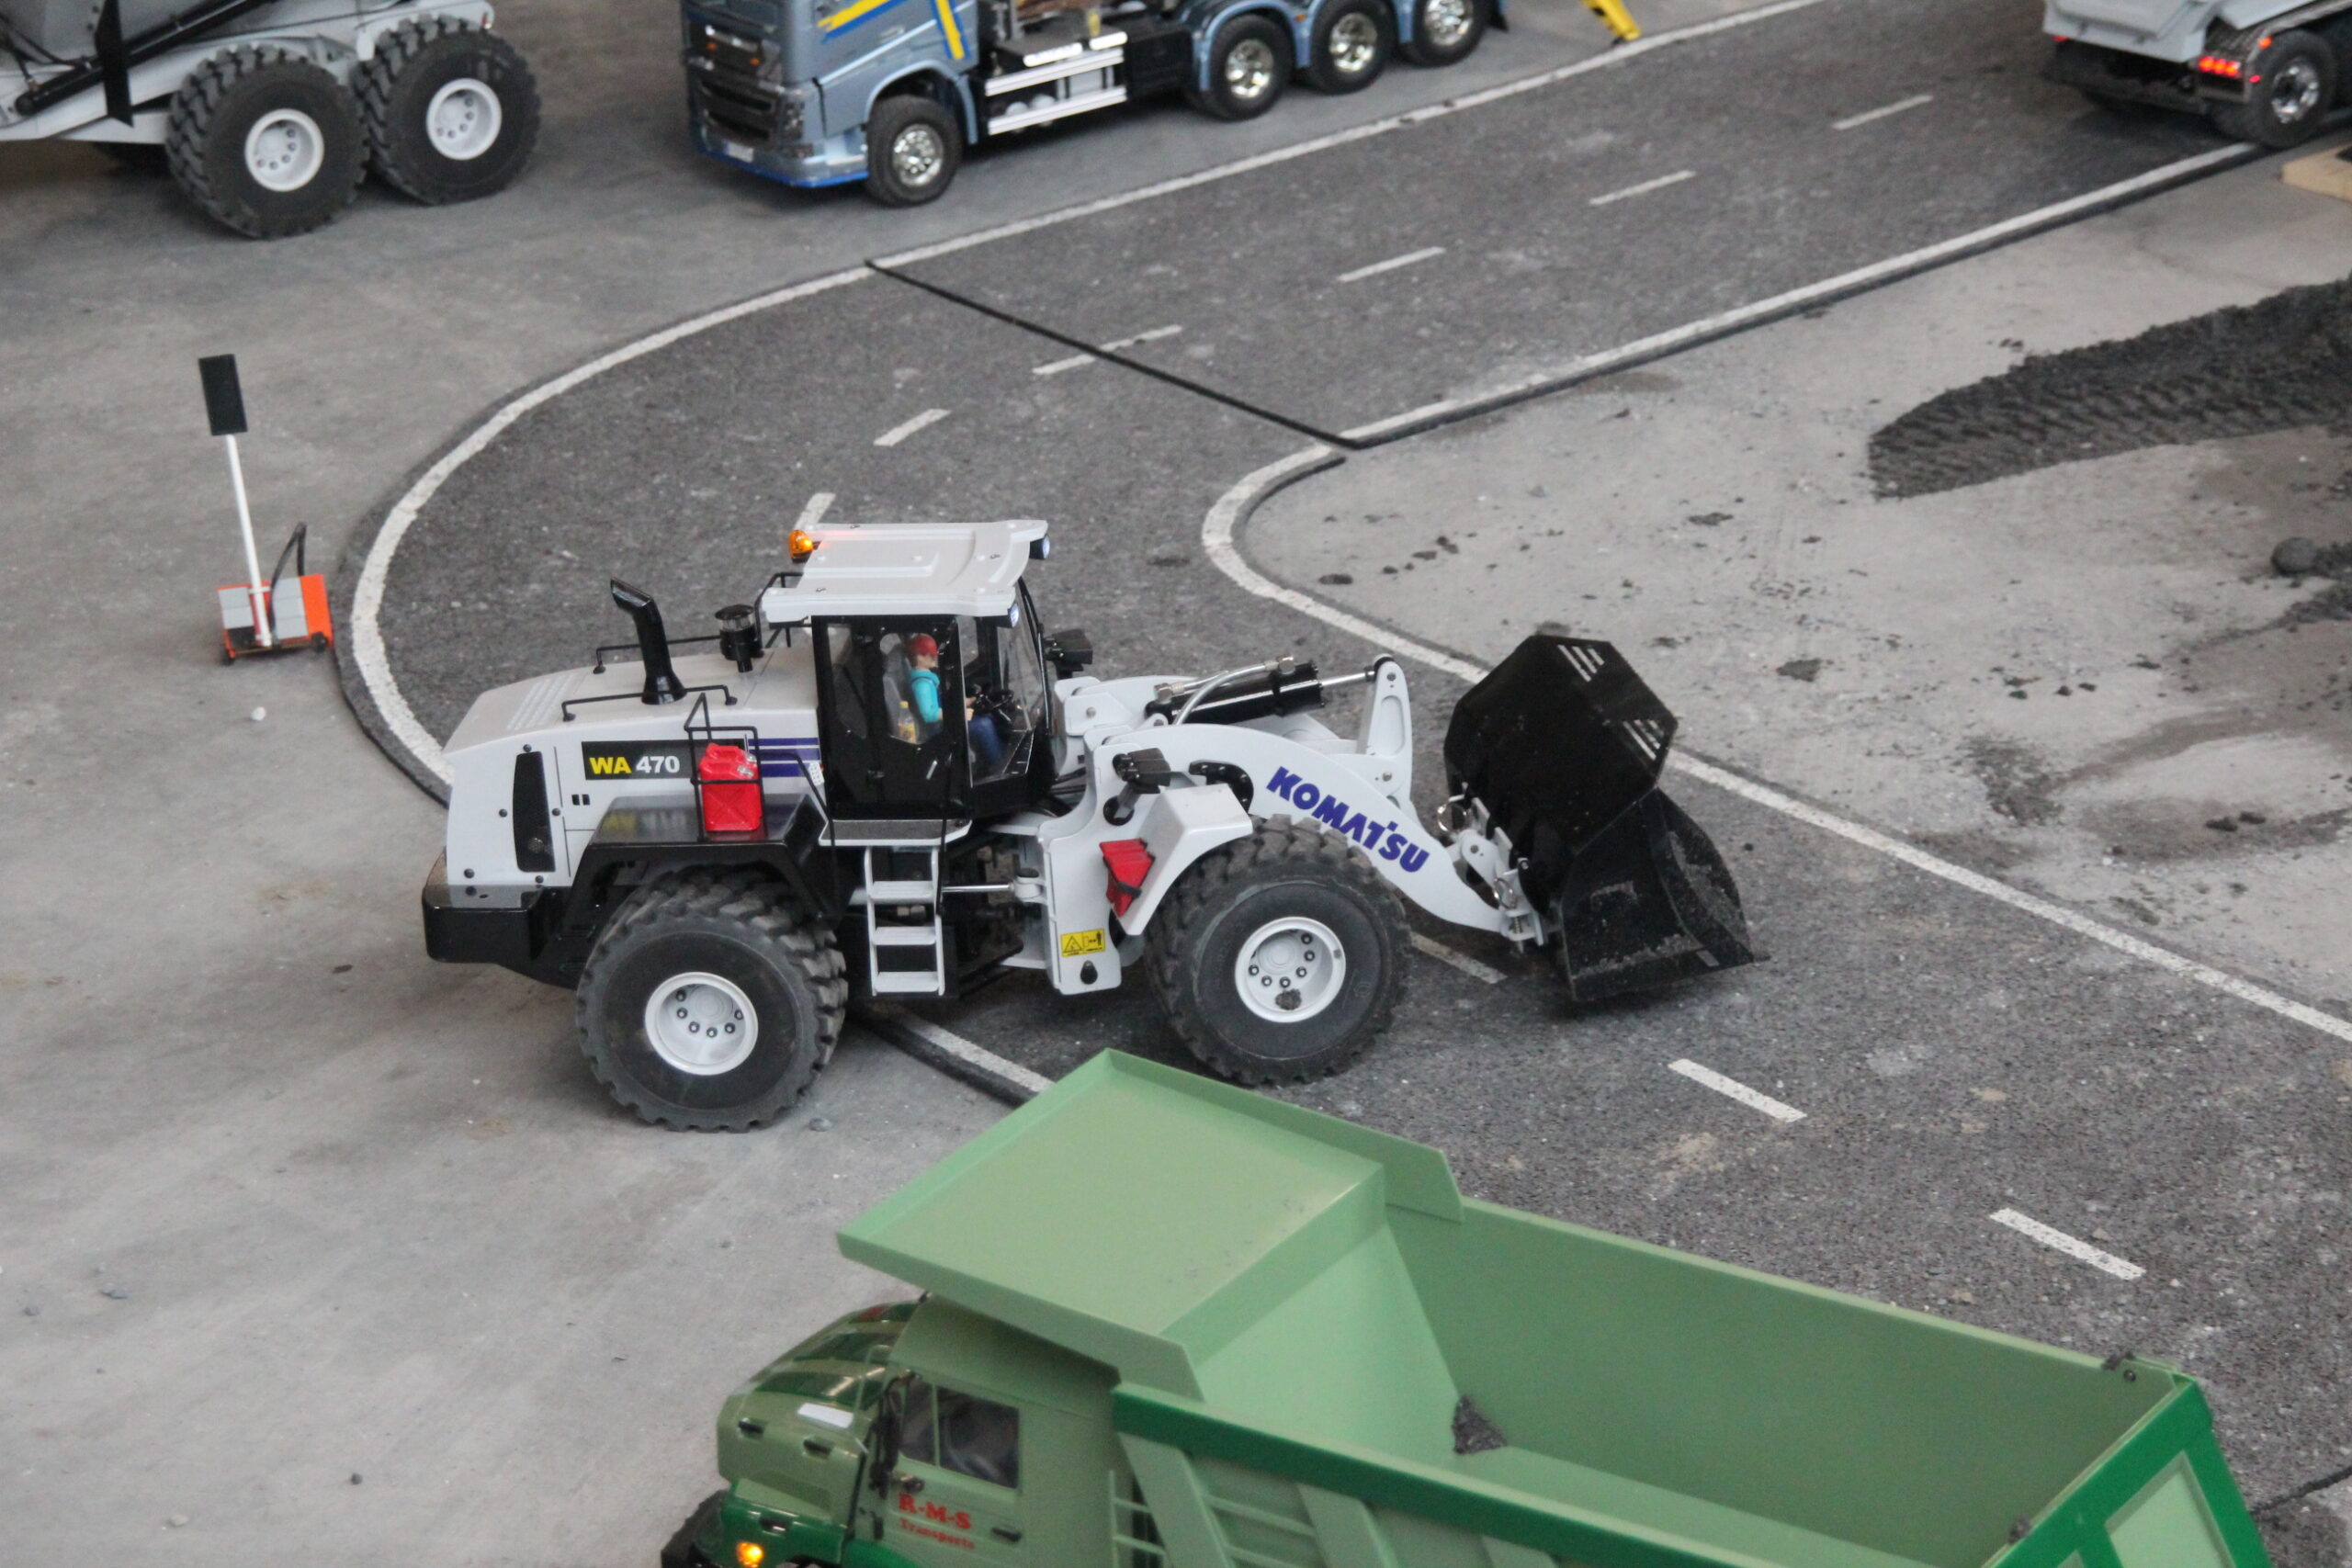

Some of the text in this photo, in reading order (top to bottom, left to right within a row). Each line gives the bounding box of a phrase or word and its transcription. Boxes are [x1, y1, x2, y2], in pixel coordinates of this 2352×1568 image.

[589, 756, 680, 774] WA 470
[1266, 766, 1430, 873] KOMATSU
